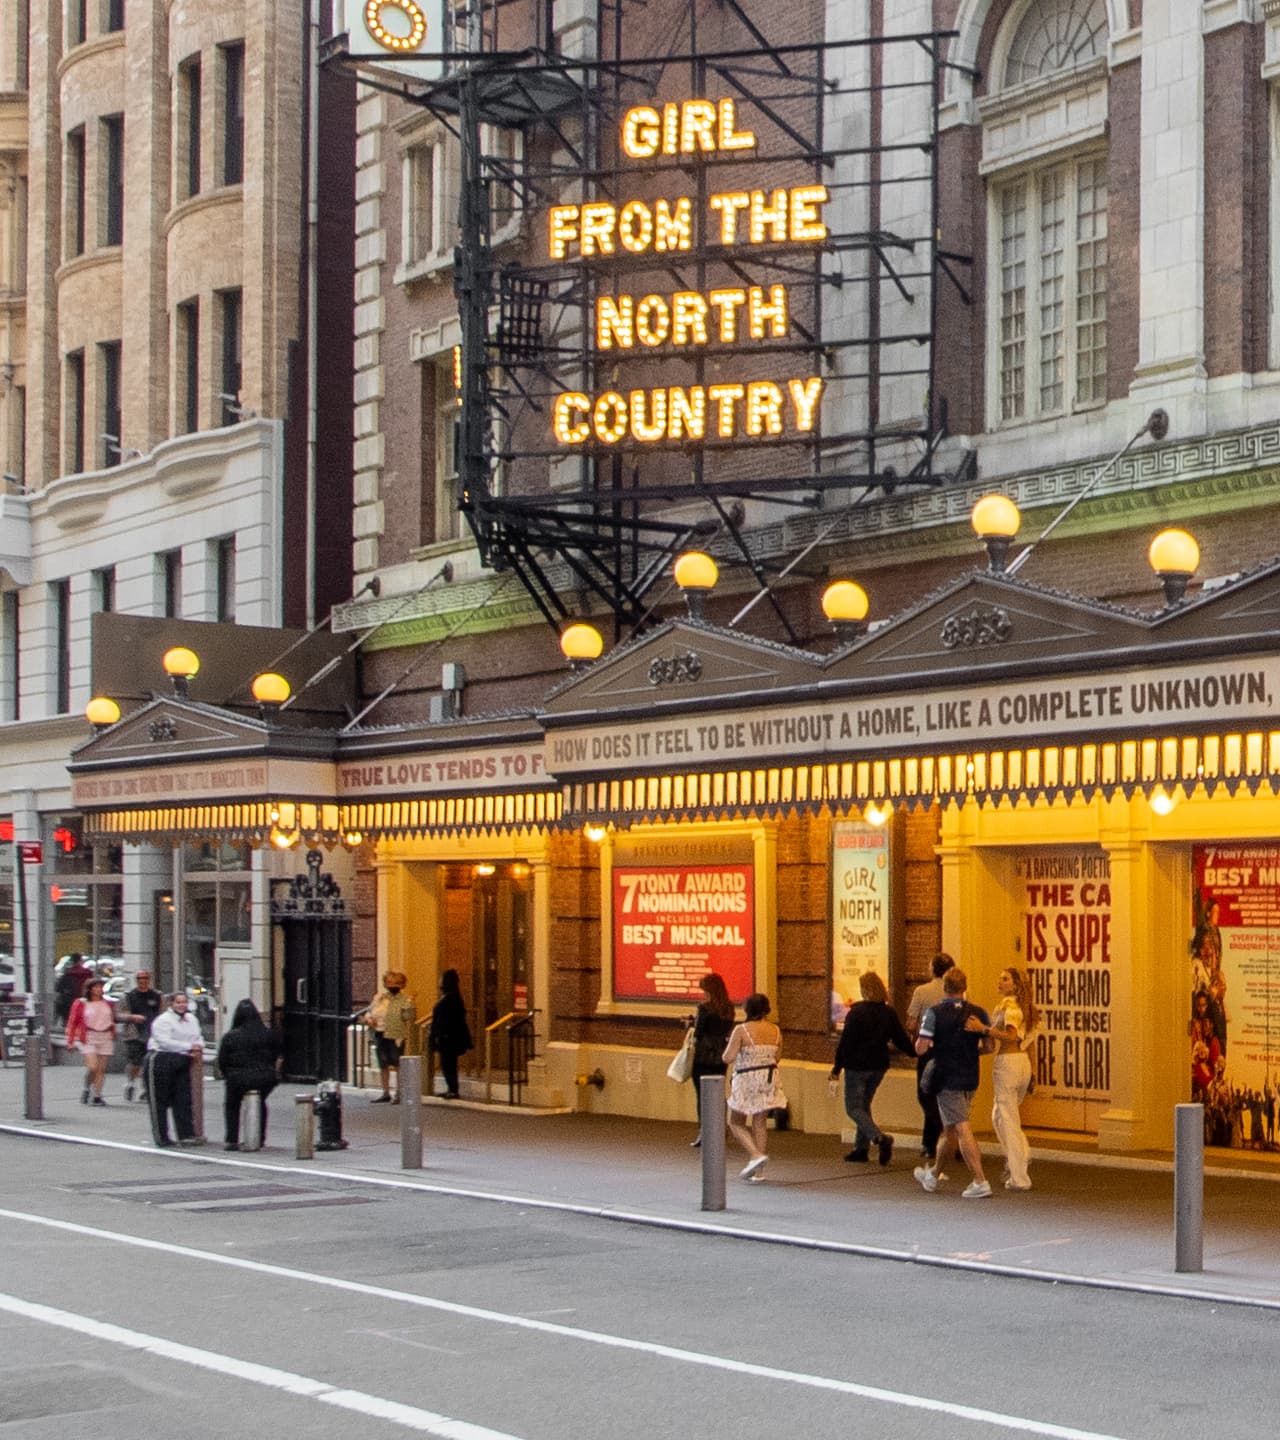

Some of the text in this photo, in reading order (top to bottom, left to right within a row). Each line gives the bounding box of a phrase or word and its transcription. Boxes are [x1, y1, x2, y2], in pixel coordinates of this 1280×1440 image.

[621, 97, 755, 160] GIRL
[548, 184, 828, 259] FROM THE
[596, 284, 789, 351] NORTH
[552, 375, 823, 444] COUNTRY
[554, 738, 588, 761] HOW
[592, 733, 632, 760] DOES
[636, 731, 650, 756] IT
[655, 728, 693, 755] FEEL
[697, 725, 720, 751] TO
[724, 722, 746, 749] BE
[749, 714, 834, 747] WITHOUT
[840, 712, 852, 739] A
[857, 698, 921, 738] HOME,
[926, 700, 972, 732] LIKE
[978, 698, 994, 726] A
[998, 685, 1124, 725] COMPLETE
[1131, 671, 1273, 714] UNKNOWN,
[341, 753, 546, 788] TRUE LOVE TENDS TO F
[1034, 856, 1079, 880] RAVISHING
[1205, 848, 1217, 867] 7
[844, 867, 877, 892] GIRL
[1204, 867, 1253, 887] BEST
[619, 872, 746, 913] 7 TONY AWARD
[638, 892, 747, 913] NOMINATIONS
[1026, 884, 1075, 907] THE
[656, 914, 708, 924] INCLUDING
[839, 898, 882, 921] NORTH
[622, 925, 745, 946] BEST MUSICAL
[842, 926, 879, 948] COUNTRY
[1026, 913, 1048, 963] IS
[1027, 968, 1111, 1008] THE HARMO
[1046, 1010, 1112, 1033] THE ENSE
[1037, 1034, 1111, 1091] RE GLORI
